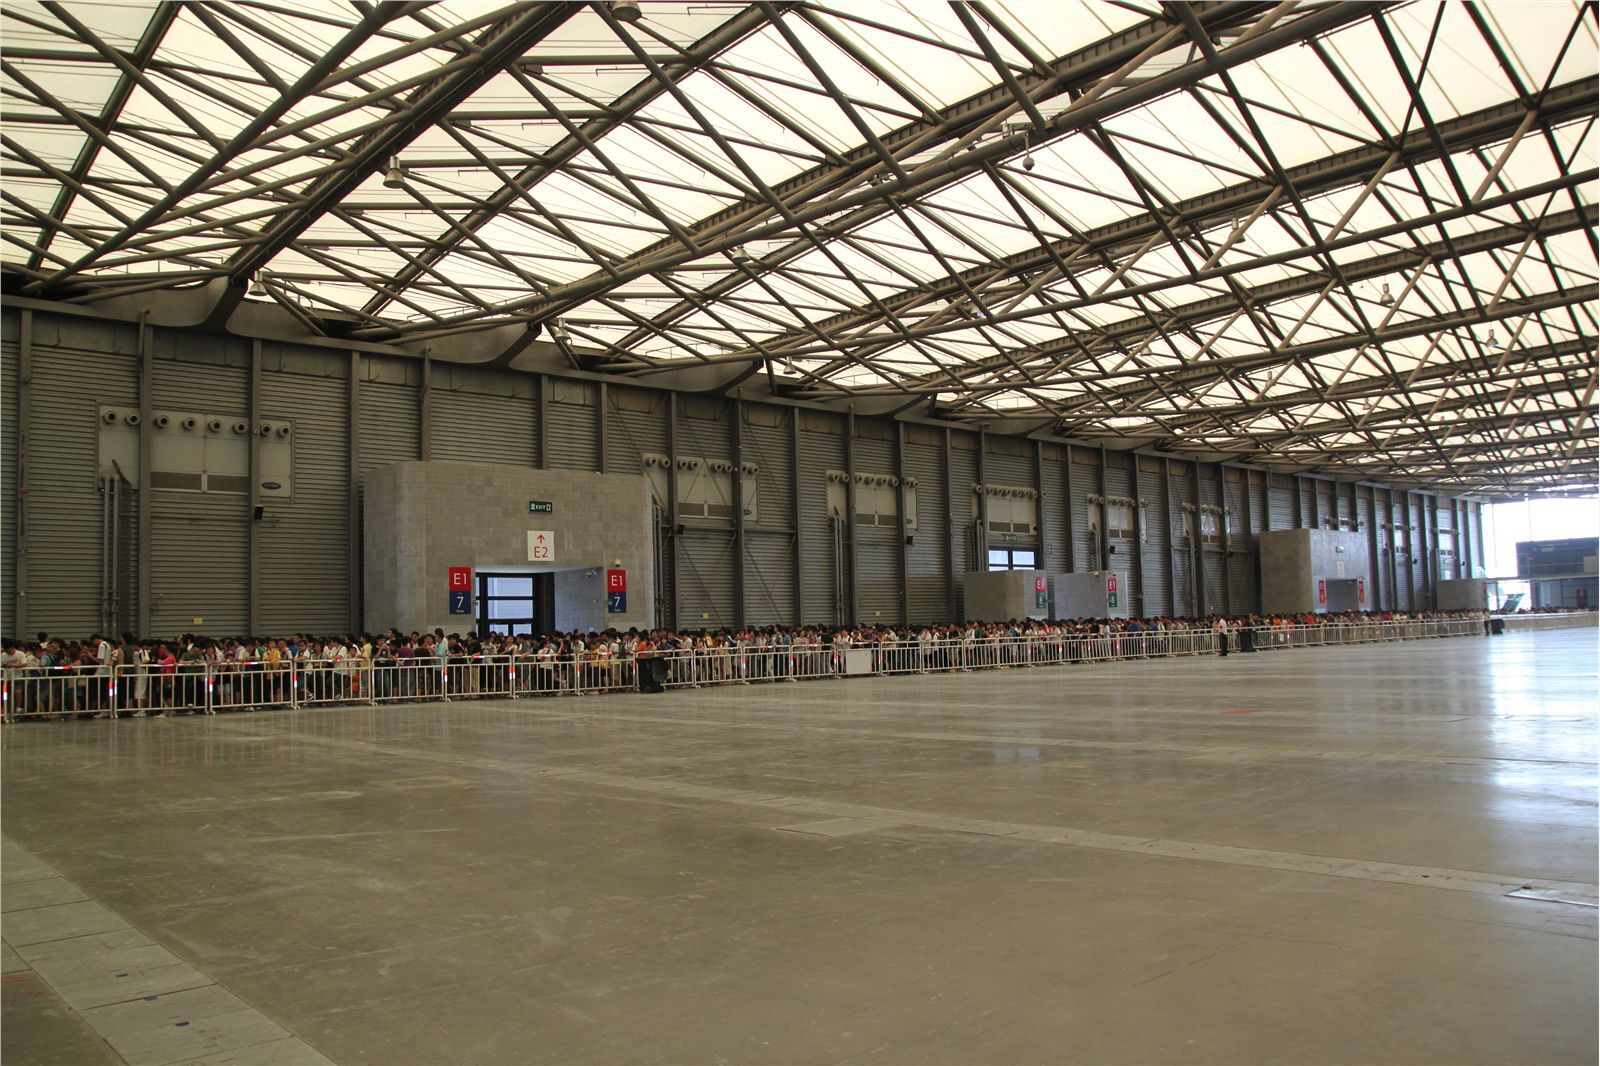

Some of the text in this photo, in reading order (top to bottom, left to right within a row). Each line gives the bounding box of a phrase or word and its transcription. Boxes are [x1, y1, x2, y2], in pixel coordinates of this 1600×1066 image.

[534, 546, 548, 558] E2
[453, 573, 467, 585] E1
[611, 575, 623, 586] E1
[456, 596, 464, 608] 7
[614, 596, 621, 607] 7
